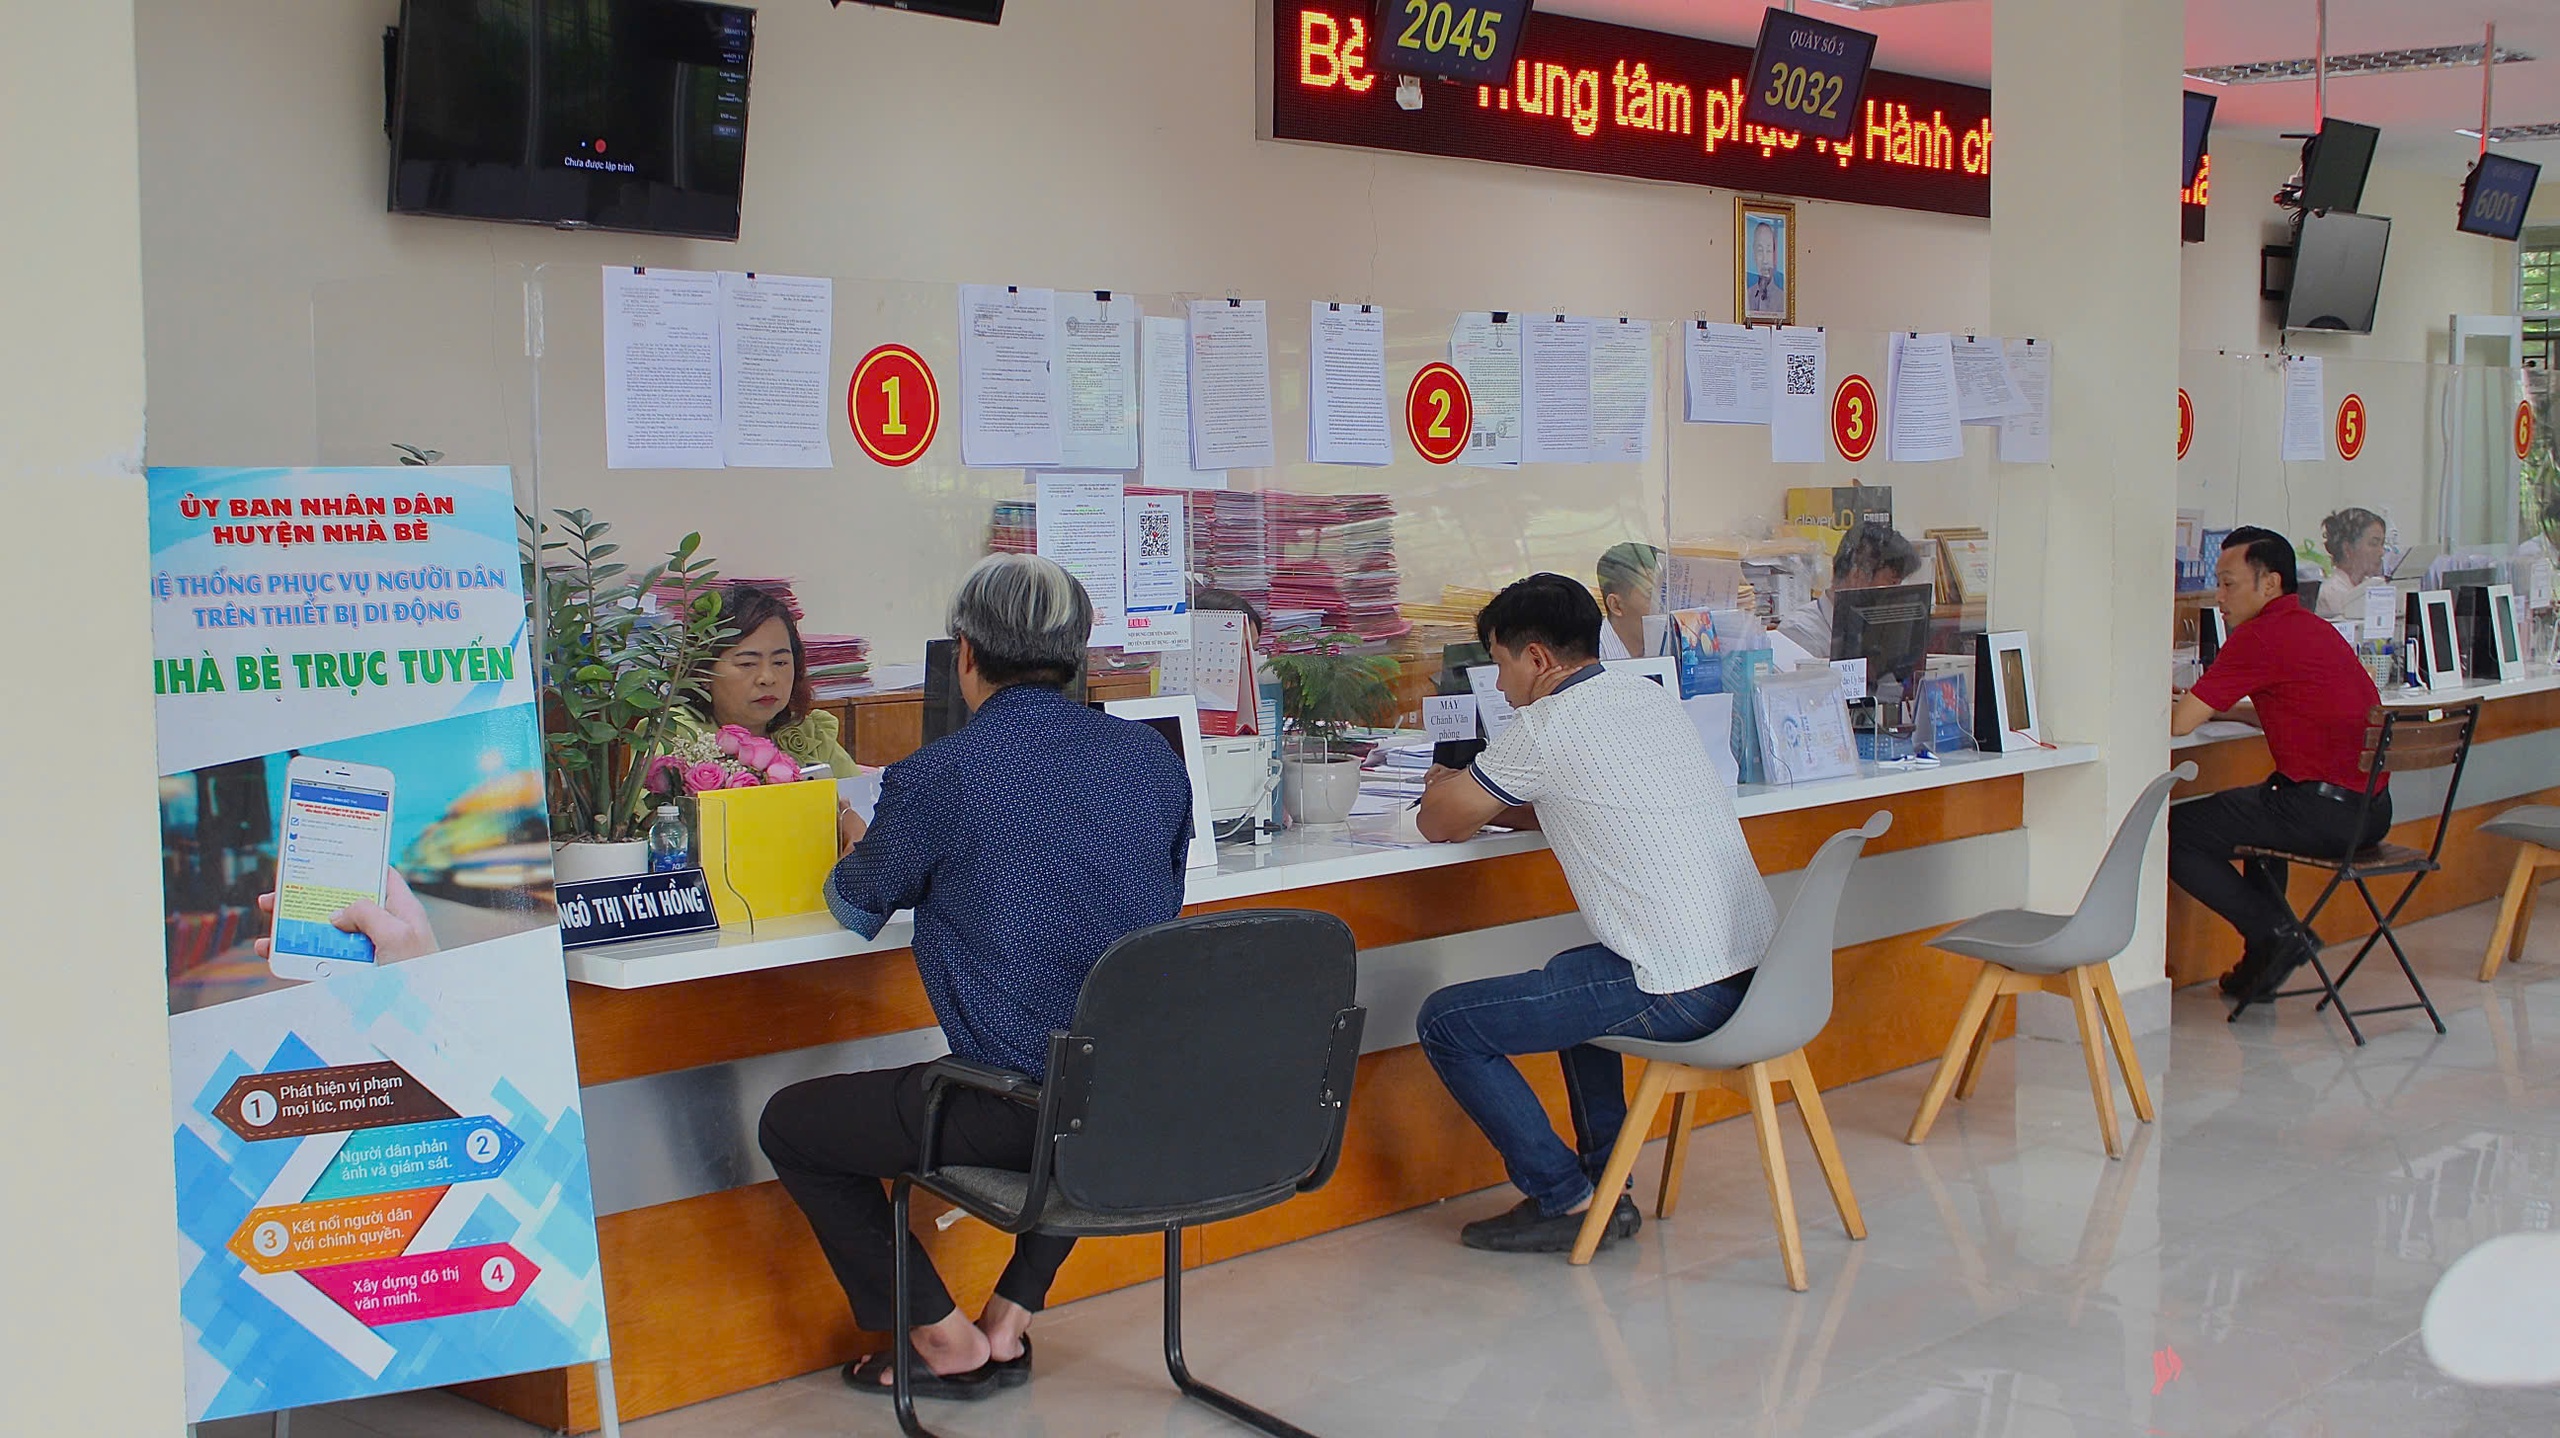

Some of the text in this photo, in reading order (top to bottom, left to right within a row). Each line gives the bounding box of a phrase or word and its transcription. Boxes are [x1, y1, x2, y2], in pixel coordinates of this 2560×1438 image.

[1398, 0, 1502, 61] 2045
[1790, 29, 1845, 57] QUẦY SỐ 3
[1765, 62, 1844, 119] 3032
[1613, 59, 1692, 135] tâm
[1866, 100, 1953, 170] Hành
[564, 157, 584, 167] Chưa
[585, 159, 604, 170] được
[2475, 188, 2519, 223] 6001
[881, 376, 907, 435] 1
[1428, 388, 1451, 438] 2
[1846, 397, 1863, 440] 3
[2345, 410, 2357, 443] 5
[2518, 415, 2528, 445] 6
[180, 493, 454, 519] ỦY BAN NHÂN DÂN
[213, 518, 429, 548] HUYỆN NHÀ BÈ
[177, 566, 262, 596] THỐNG
[268, 573, 335, 601] PHỤC
[343, 572, 370, 596] VỤ
[377, 565, 452, 592] NGƯỜI
[457, 563, 507, 590] DÂN
[194, 598, 461, 630] TRÊN THIẾT BỊ DI ĐỘNG
[235, 647, 282, 692] BÈ
[293, 652, 388, 697] TRỰC
[400, 636, 515, 685] TUYẾN
[1440, 697, 1459, 710] MÁY
[1454, 714, 1468, 723] Văn
[558, 878, 706, 931] NGÔ THỊ YẾN HỒNG
[280, 1083, 312, 1100] Phát
[315, 1080, 345, 1097] hiện
[364, 1075, 403, 1094] phạm
[251, 1099, 262, 1118] 1
[282, 1092, 395, 1120] mọi lúc, mọi nơi.
[340, 1138, 448, 1165] Người dân phản
[475, 1135, 490, 1155] 2
[342, 1154, 453, 1181] ánh và giám sát.
[292, 1207, 413, 1234] Kết nối người dân
[263, 1230, 277, 1249] 3
[293, 1225, 405, 1251] với chính quyền.
[353, 1265, 459, 1297] Xây dựng đô thị
[491, 1264, 505, 1283] 4
[355, 1289, 421, 1311] văn minh.
